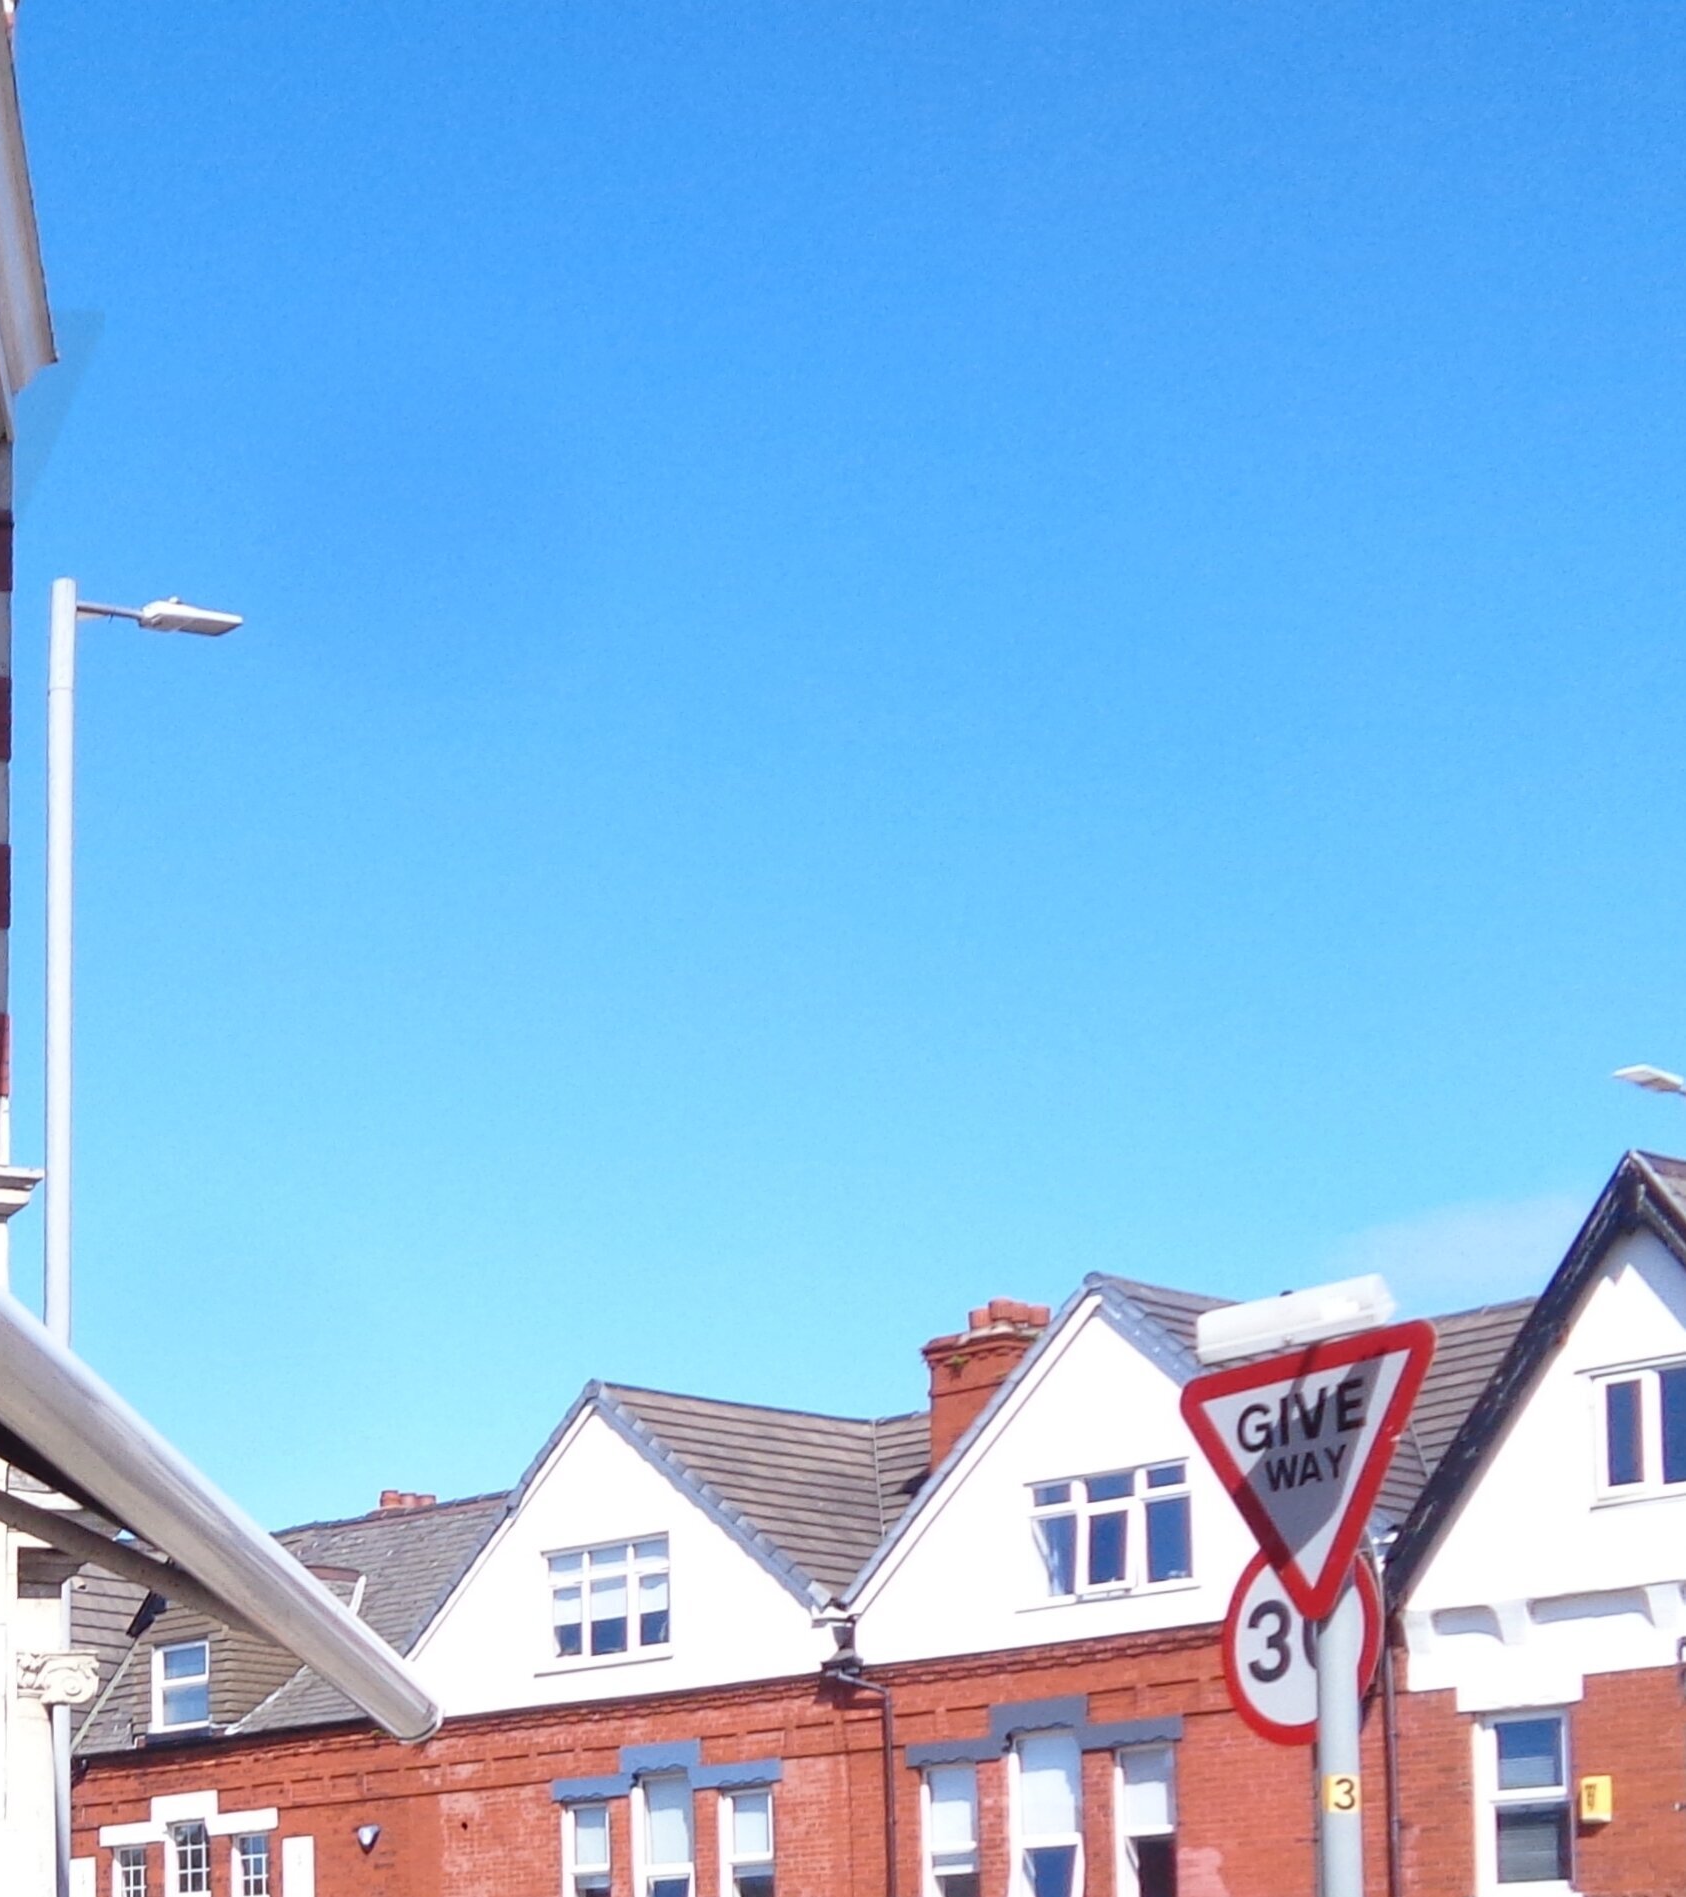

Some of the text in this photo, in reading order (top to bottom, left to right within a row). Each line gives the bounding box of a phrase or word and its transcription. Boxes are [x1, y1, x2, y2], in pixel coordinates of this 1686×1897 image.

[1236, 1378, 1367, 1454] GIVE
[1265, 1443, 1348, 1493] WAY
[1333, 1778, 1356, 1812] 3
